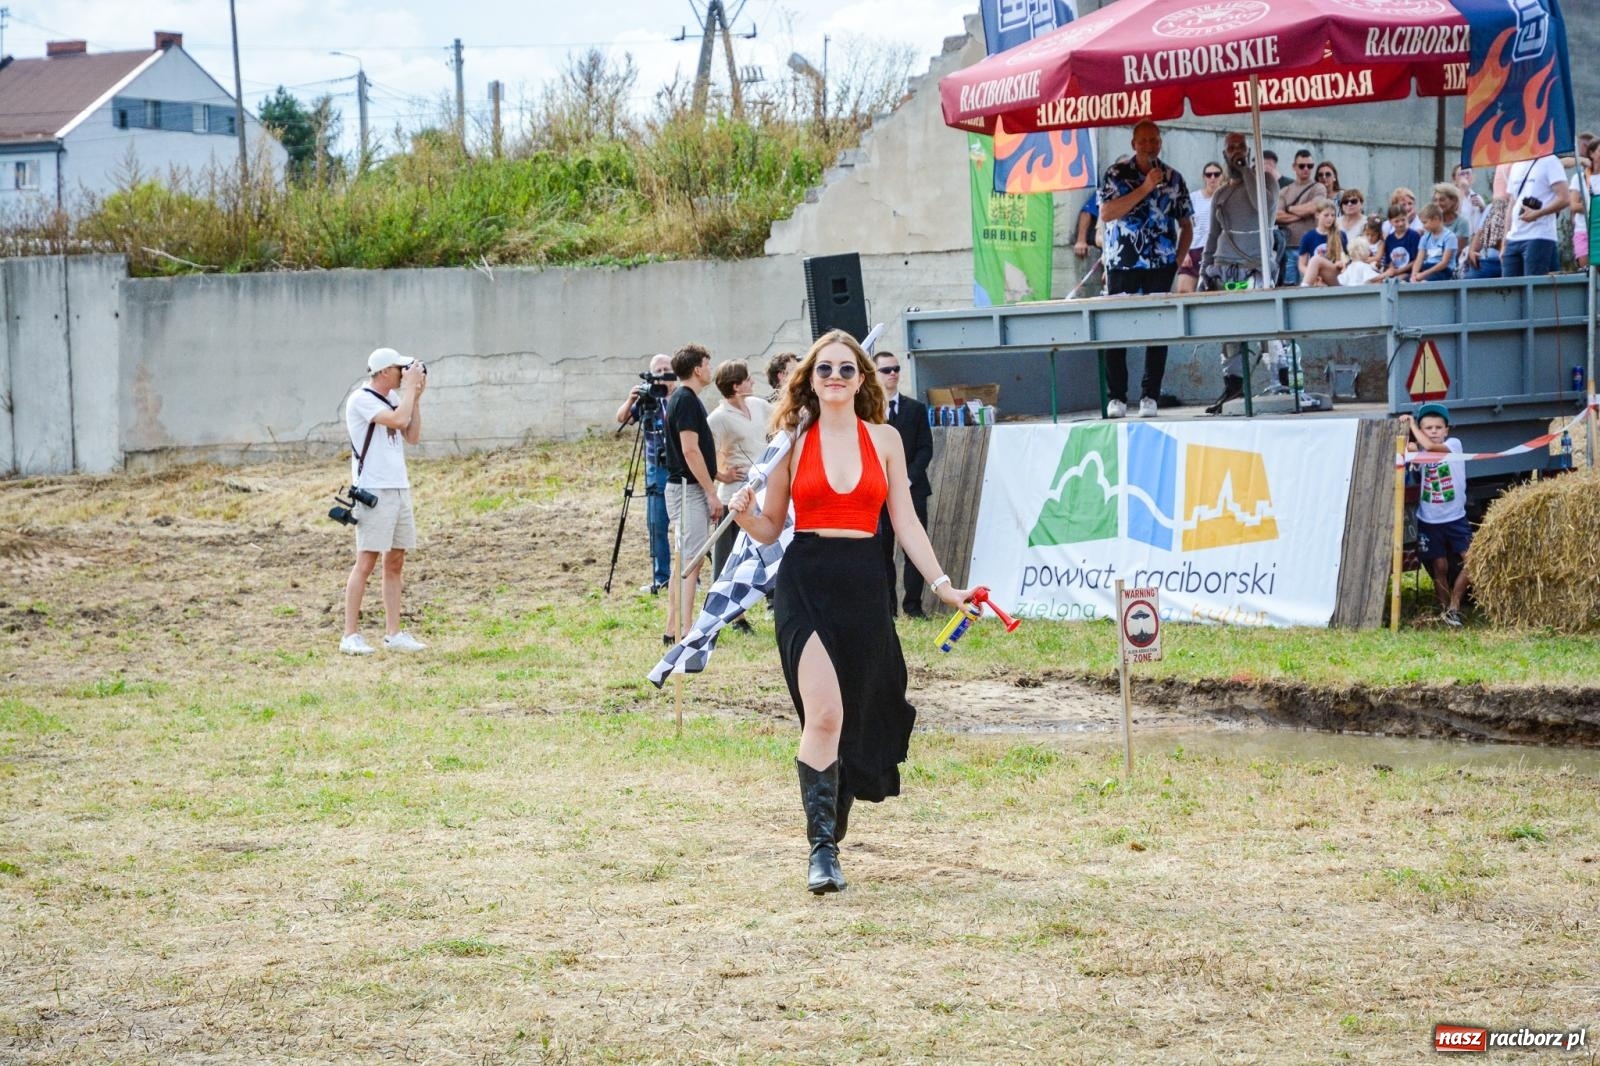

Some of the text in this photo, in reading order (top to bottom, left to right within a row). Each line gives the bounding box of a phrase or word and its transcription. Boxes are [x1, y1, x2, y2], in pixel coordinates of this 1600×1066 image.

[1365, 24, 1470, 57] RACIBORSK
[1122, 35, 1280, 85] RACIBORSKIE
[960, 69, 1042, 113] RACIBORSKIE
[983, 228, 1037, 242] BABILAS
[1020, 559, 1276, 596] powiat raciborski
[1124, 588, 1155, 599] WARNING
[1133, 653, 1152, 663] ZONE
